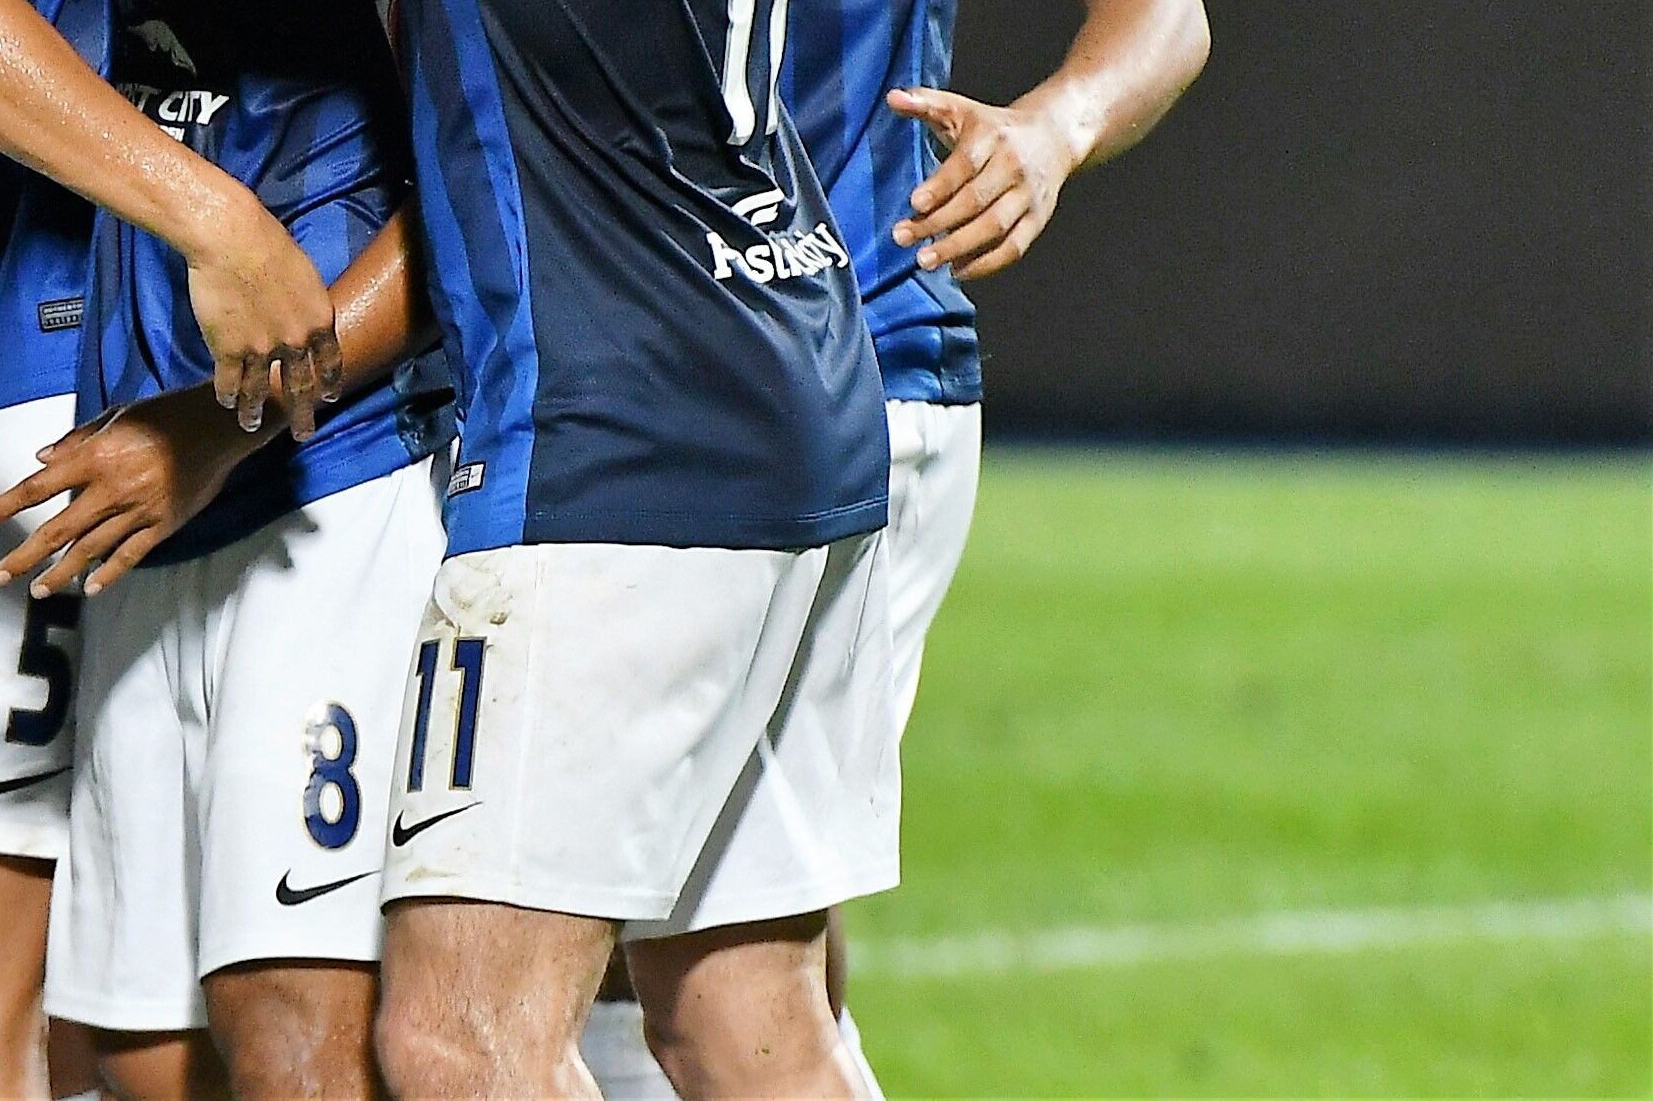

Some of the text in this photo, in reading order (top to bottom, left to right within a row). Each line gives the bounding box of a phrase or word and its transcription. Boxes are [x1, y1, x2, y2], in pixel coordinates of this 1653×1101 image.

[158, 89, 230, 125] CITY
[6, 593, 86, 747] 5
[406, 635, 488, 794] 11
[300, 700, 364, 852] 8
